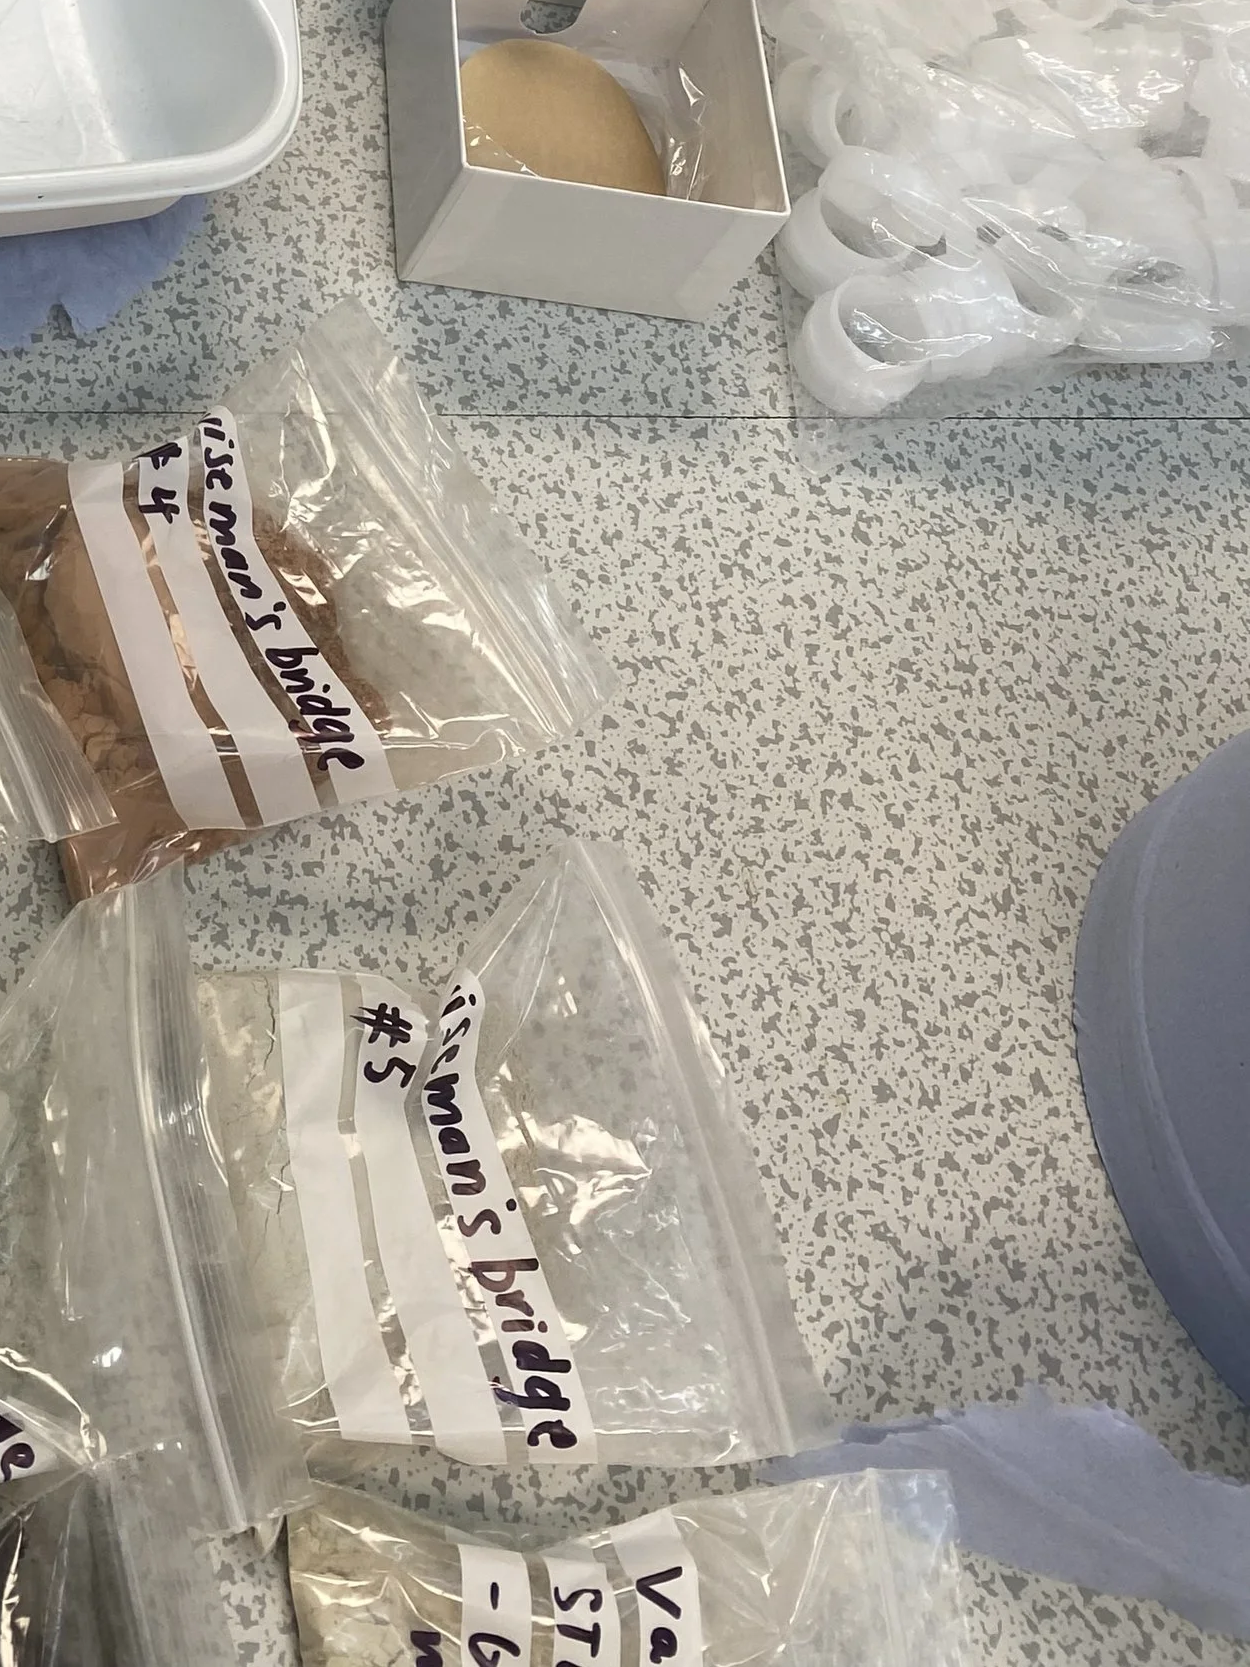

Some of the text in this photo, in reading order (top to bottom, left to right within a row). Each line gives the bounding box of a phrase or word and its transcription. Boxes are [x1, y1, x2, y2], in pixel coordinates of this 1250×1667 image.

[265, 647, 366, 772] bridge
[423, 985, 578, 1450] iseman's bridge
